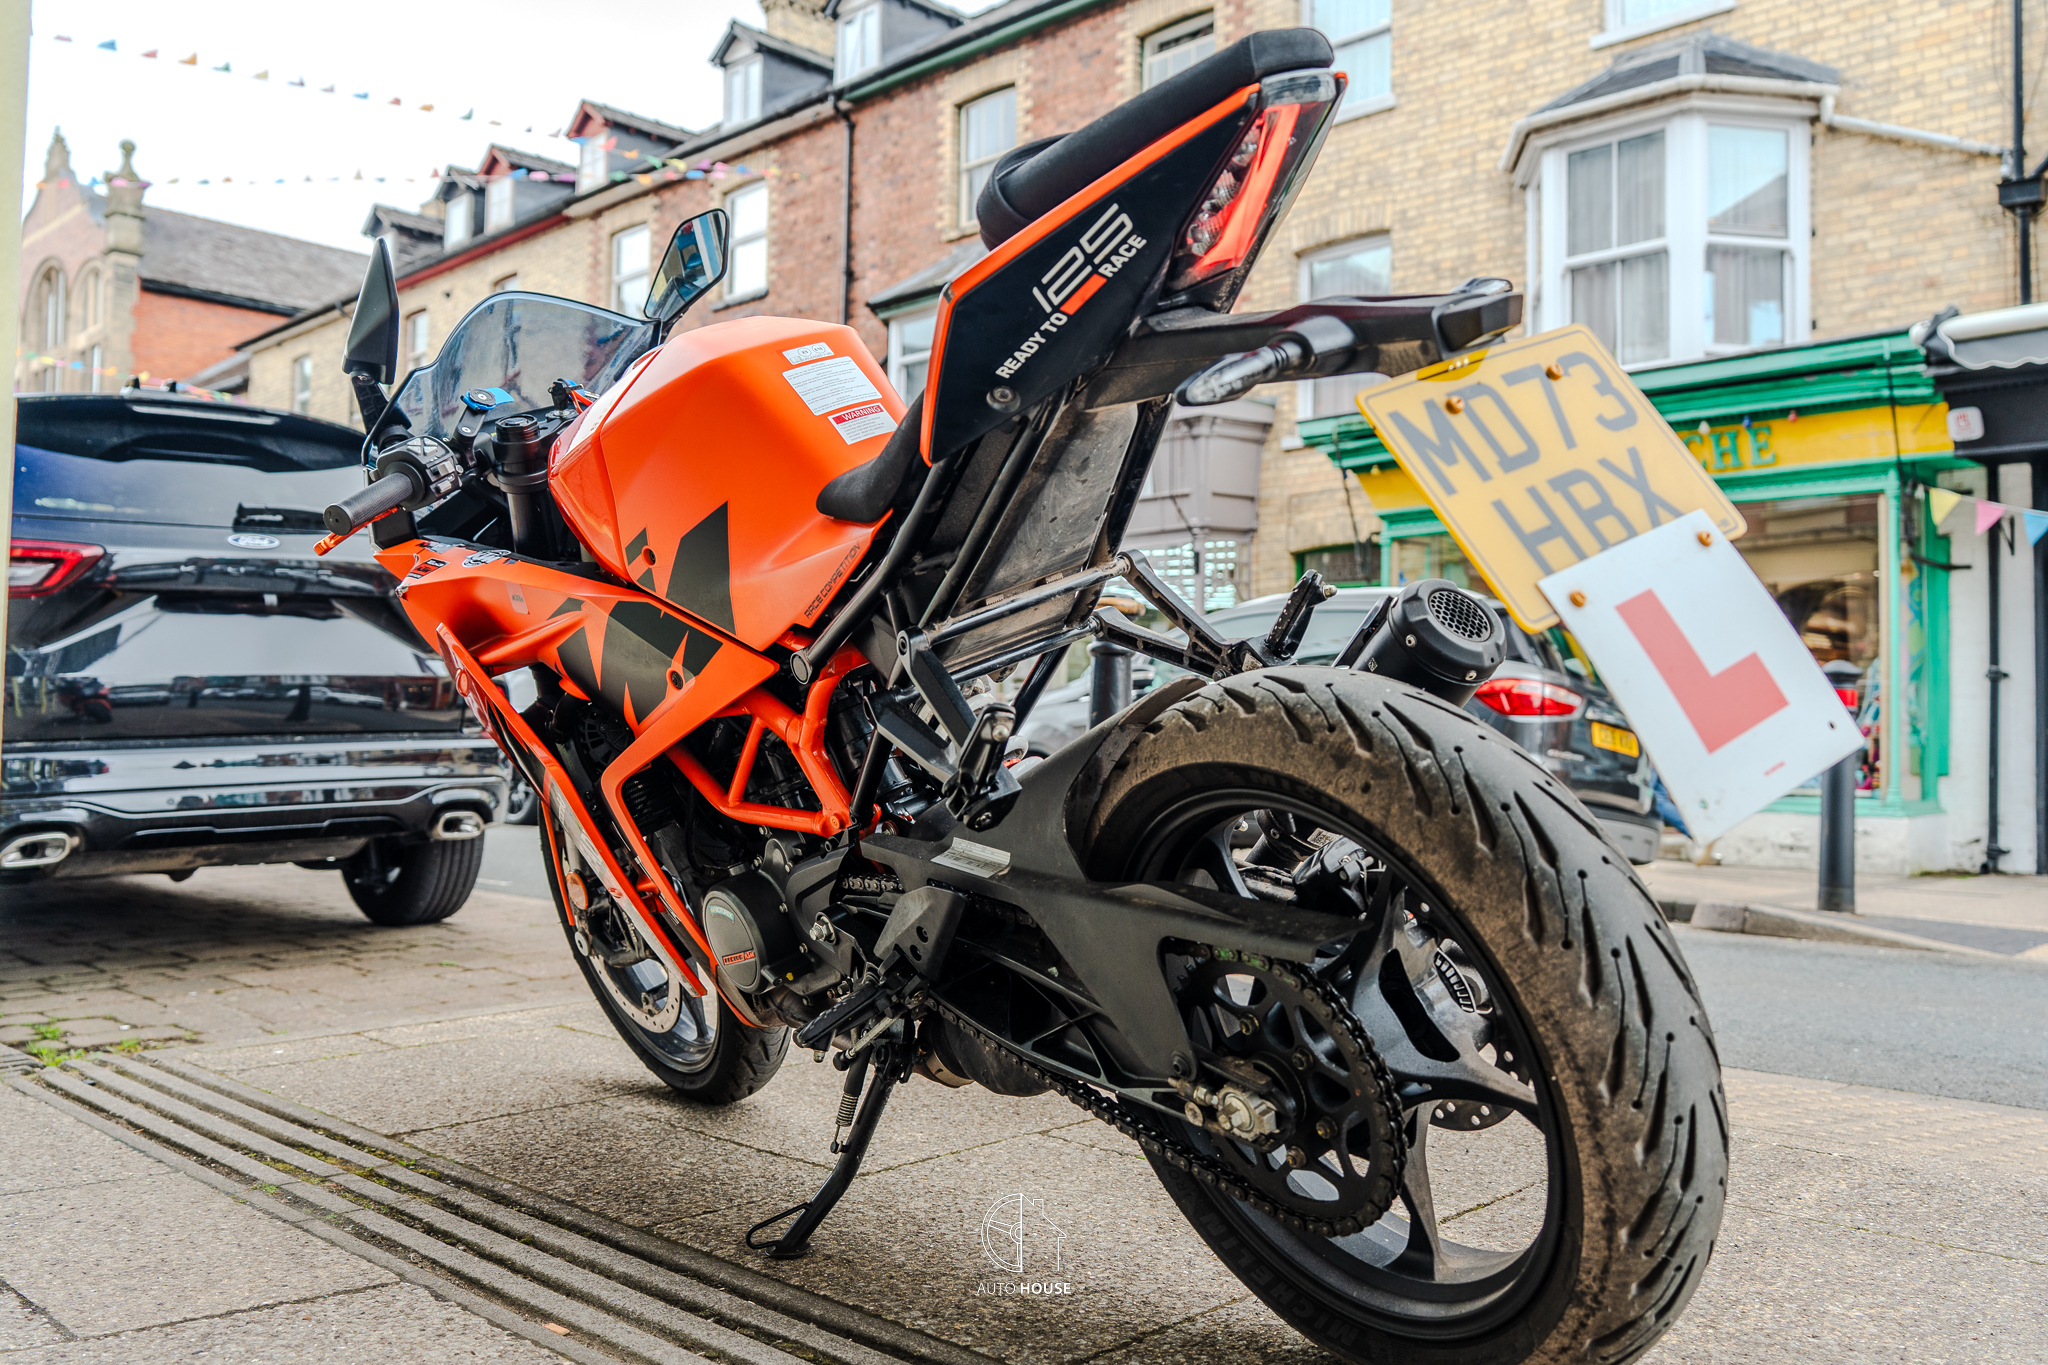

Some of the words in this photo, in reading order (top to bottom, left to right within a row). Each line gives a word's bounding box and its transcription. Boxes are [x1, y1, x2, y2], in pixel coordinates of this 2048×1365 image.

[995, 331, 1046, 379] READY
[1040, 312, 1068, 333] TO
[1098, 234, 1147, 278] RACE
[1032, 203, 1133, 313] 125
[842, 404, 881, 420] WARNING
[1387, 352, 1638, 496] MD73
[1491, 446, 1687, 576] HBX
[804, 594, 824, 618] RACE
[820, 541, 860, 598] COMPETITION
[1614, 588, 1790, 754] L
[1200, 1211, 1358, 1346] MICHELIN
